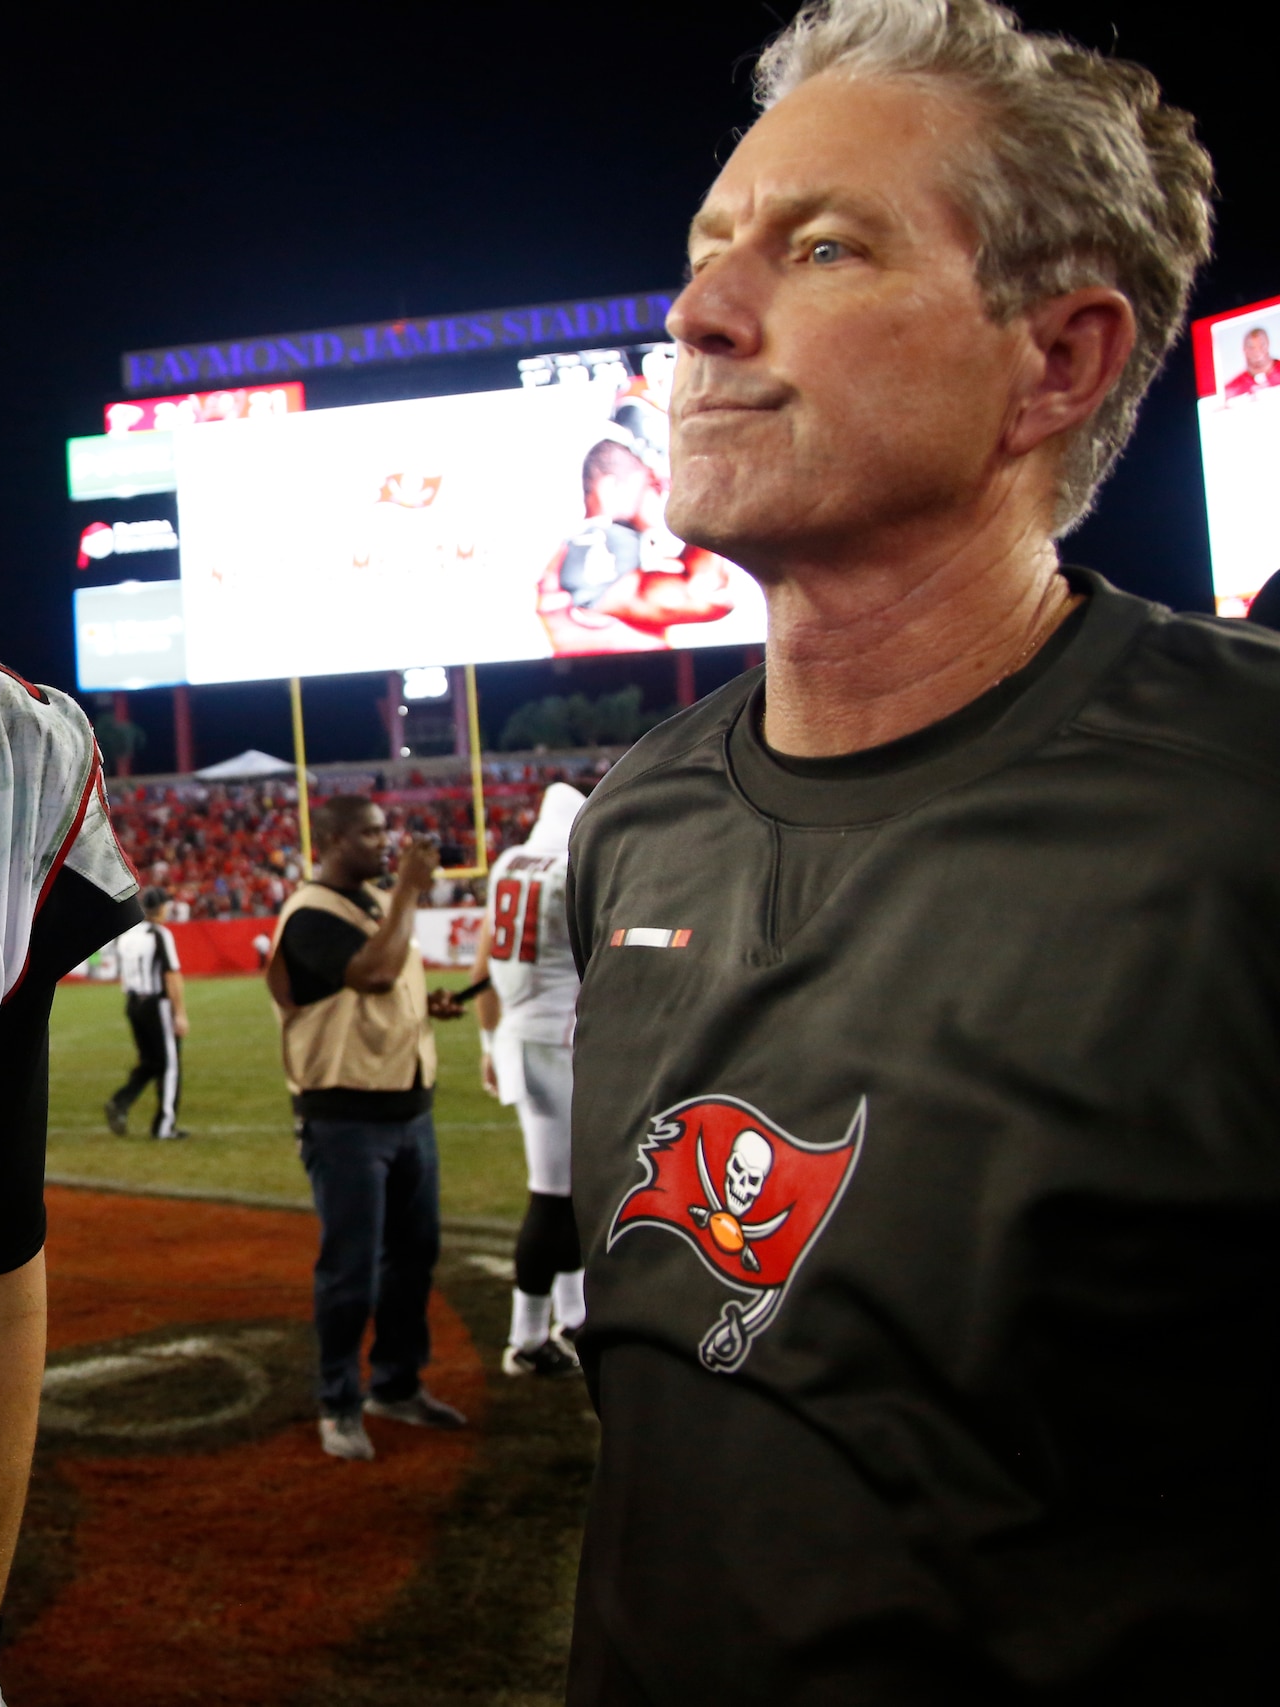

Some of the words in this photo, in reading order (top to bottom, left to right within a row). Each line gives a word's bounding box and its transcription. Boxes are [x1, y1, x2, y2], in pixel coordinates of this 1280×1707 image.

[128, 332, 344, 389] RAYMOND
[350, 314, 495, 366] JAMES
[490, 878, 543, 963] 81
